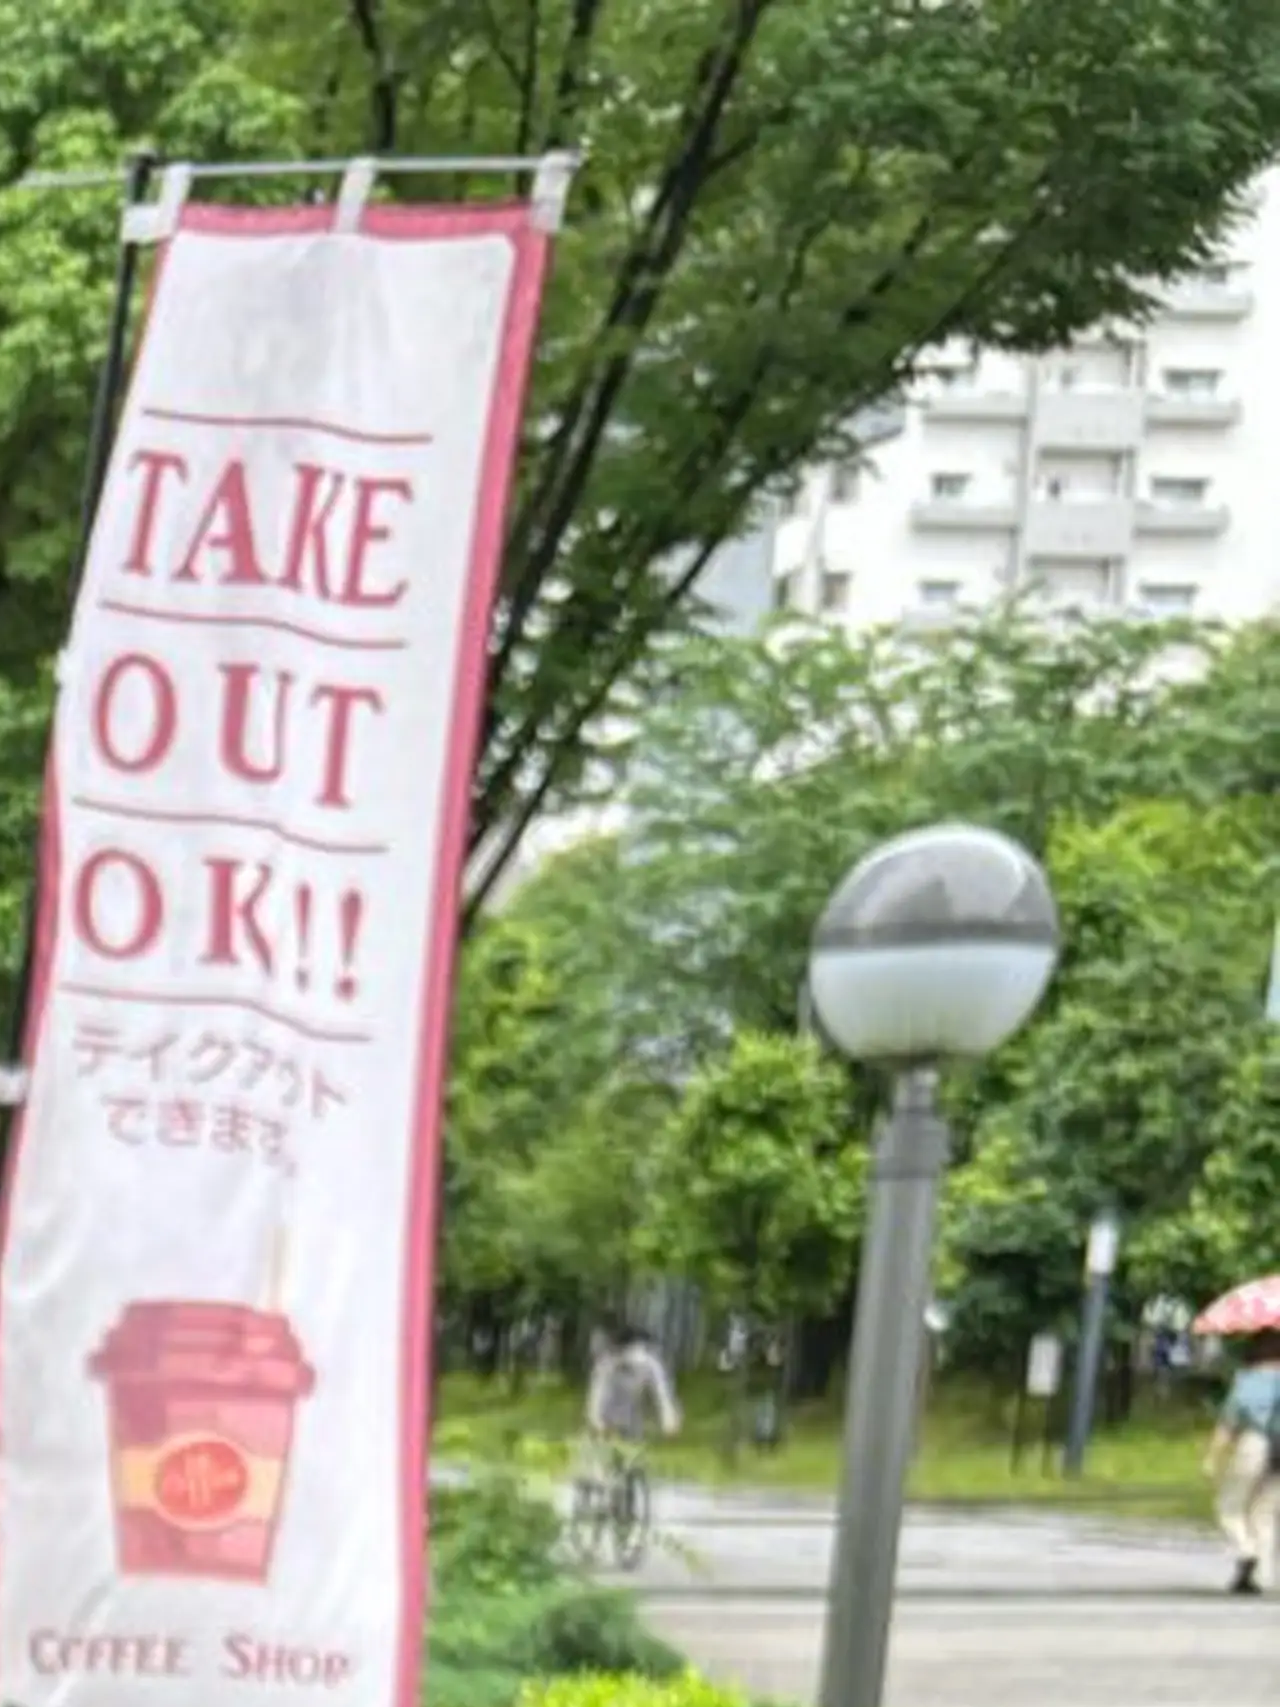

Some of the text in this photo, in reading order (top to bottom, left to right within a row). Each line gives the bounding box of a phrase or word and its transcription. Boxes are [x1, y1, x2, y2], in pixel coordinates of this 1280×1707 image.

[122, 451, 412, 607] TAKE
[90, 650, 386, 810] OUT
[71, 846, 369, 1002] OK!!
[71, 1020, 350, 1122] テイクアウト
[223, 1631, 352, 1687] SHOP
